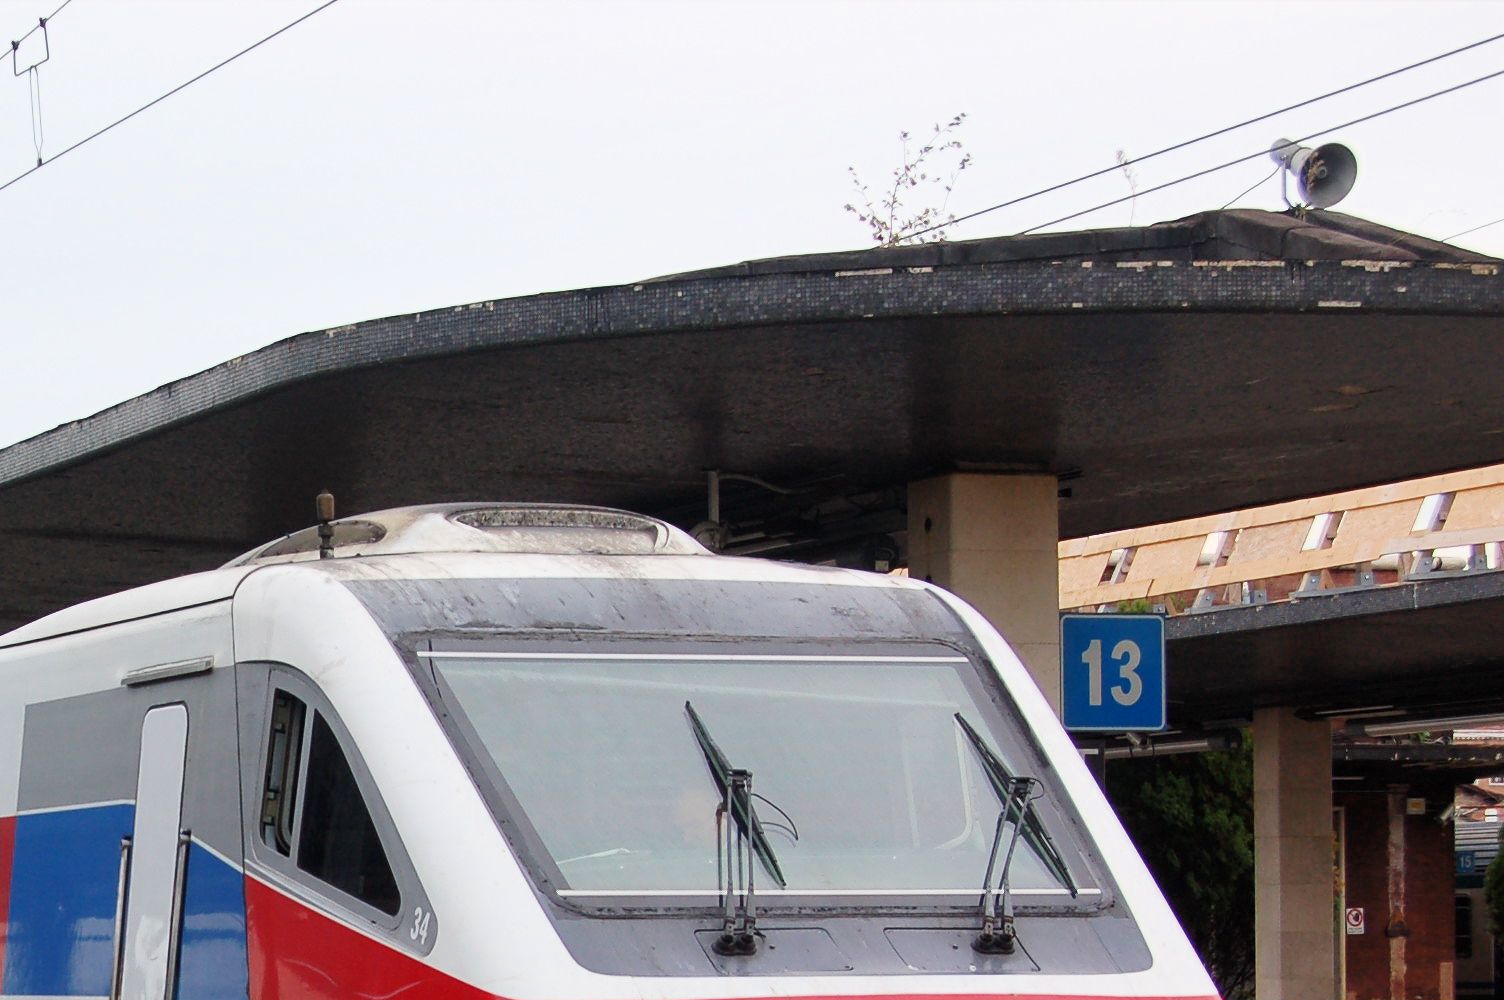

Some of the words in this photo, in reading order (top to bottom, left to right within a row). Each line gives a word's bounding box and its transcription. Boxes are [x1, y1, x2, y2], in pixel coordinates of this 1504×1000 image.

[1081, 639, 1143, 706] 13
[1461, 855, 1472, 868] 15
[410, 906, 431, 945] 34
